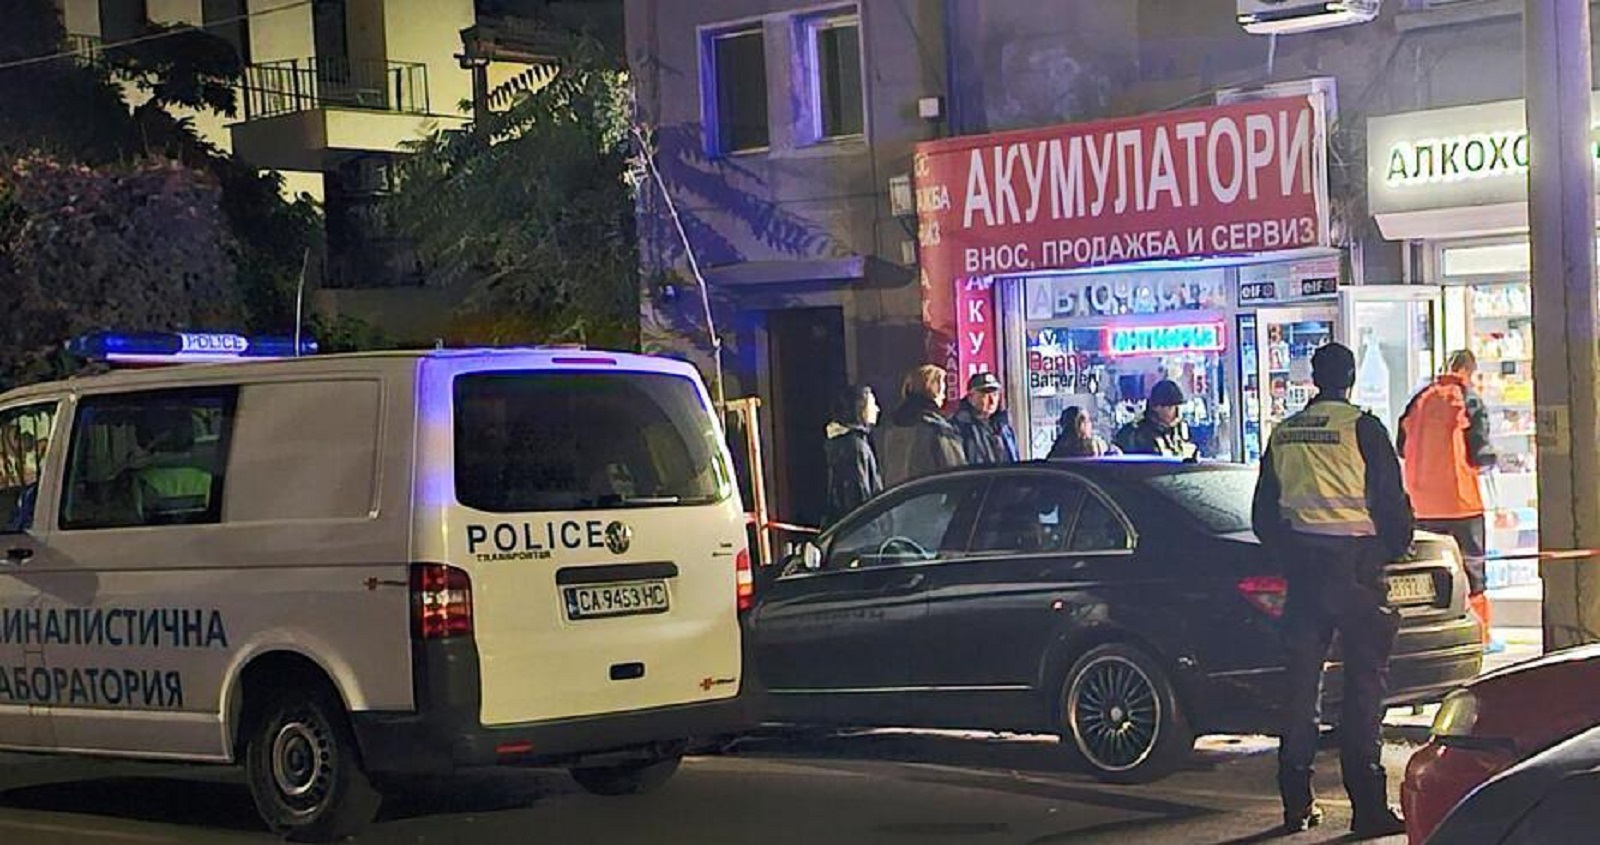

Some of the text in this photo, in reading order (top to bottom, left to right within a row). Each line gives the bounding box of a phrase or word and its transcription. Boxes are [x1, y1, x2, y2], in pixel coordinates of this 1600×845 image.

[963, 109, 1311, 229] АКУМУЛАТОРИ
[965, 217, 1315, 273] ВНОС, ПРОДАЖБА И СЕРВИЗ
[187, 334, 244, 349] POLICE
[467, 521, 604, 553] POLICE
[477, 551, 551, 562] TRANSPORTER
[603, 588, 640, 609] 9453
[0, 608, 228, 647] ИНАЛИСТИЧНА
